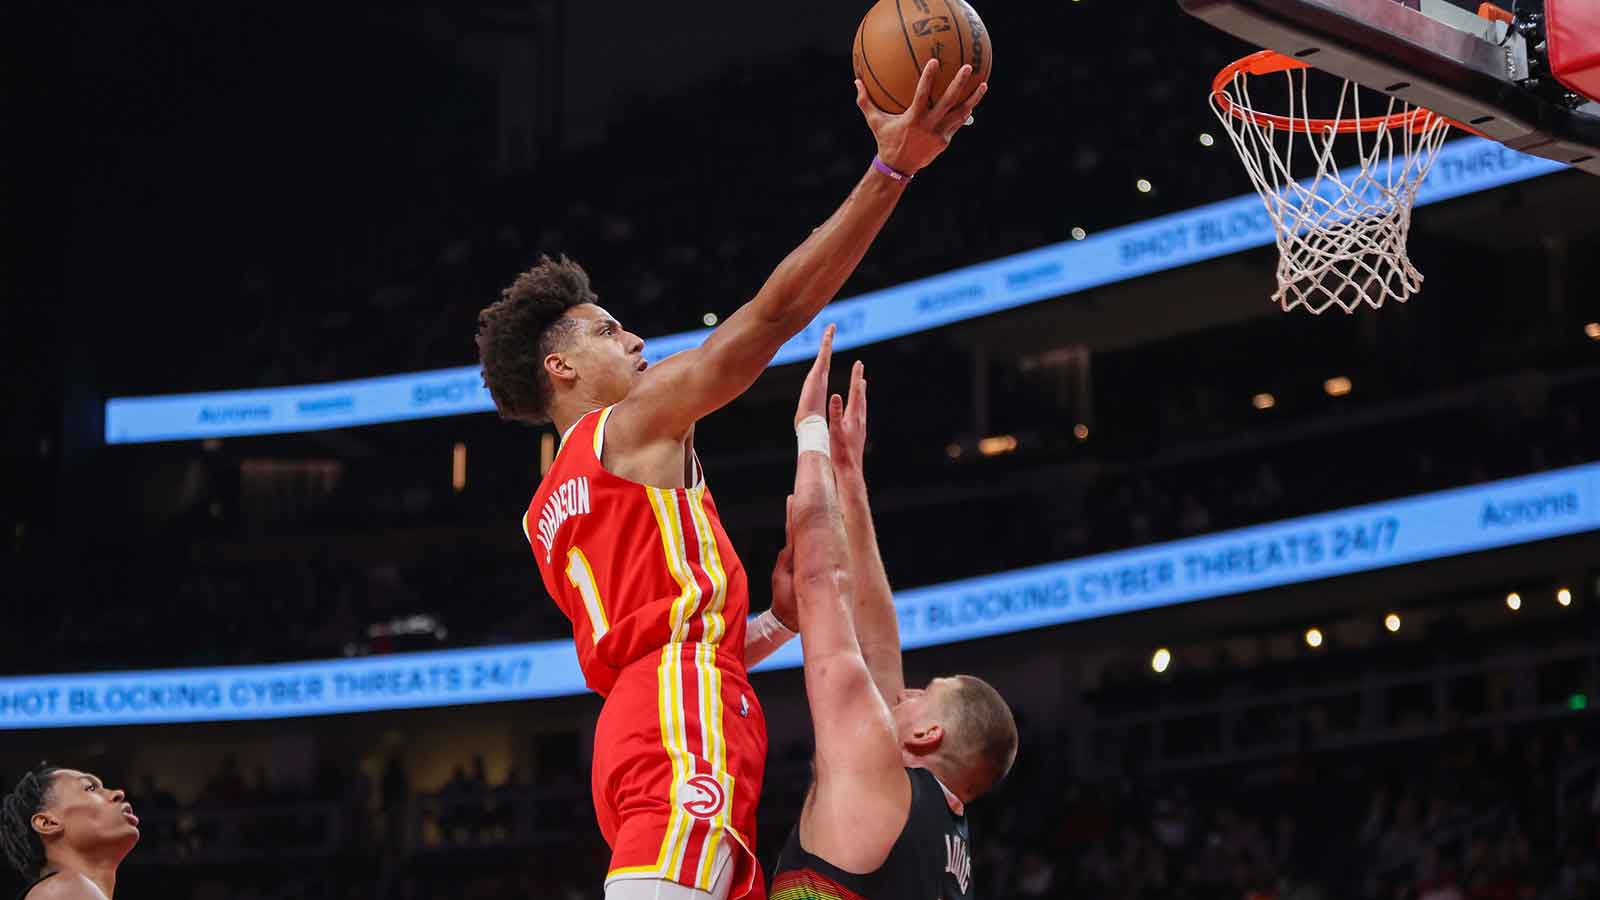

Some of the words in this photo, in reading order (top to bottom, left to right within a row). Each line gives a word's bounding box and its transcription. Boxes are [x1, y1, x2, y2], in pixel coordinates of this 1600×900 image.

[537, 476, 590, 564] JOHNSON
[924, 575, 1070, 632] BLOCKING
[1074, 555, 1176, 601] CYBER
[1184, 529, 1324, 584] THREATS
[1332, 514, 1399, 558] 24/7
[1479, 489, 1579, 529] Acronis
[565, 546, 610, 647] 1
[0, 687, 59, 716] HOT
[68, 681, 221, 715] BLOCKING
[229, 675, 324, 707] CYBER
[333, 666, 460, 698] THREATS
[470, 658, 532, 690] 24/7
